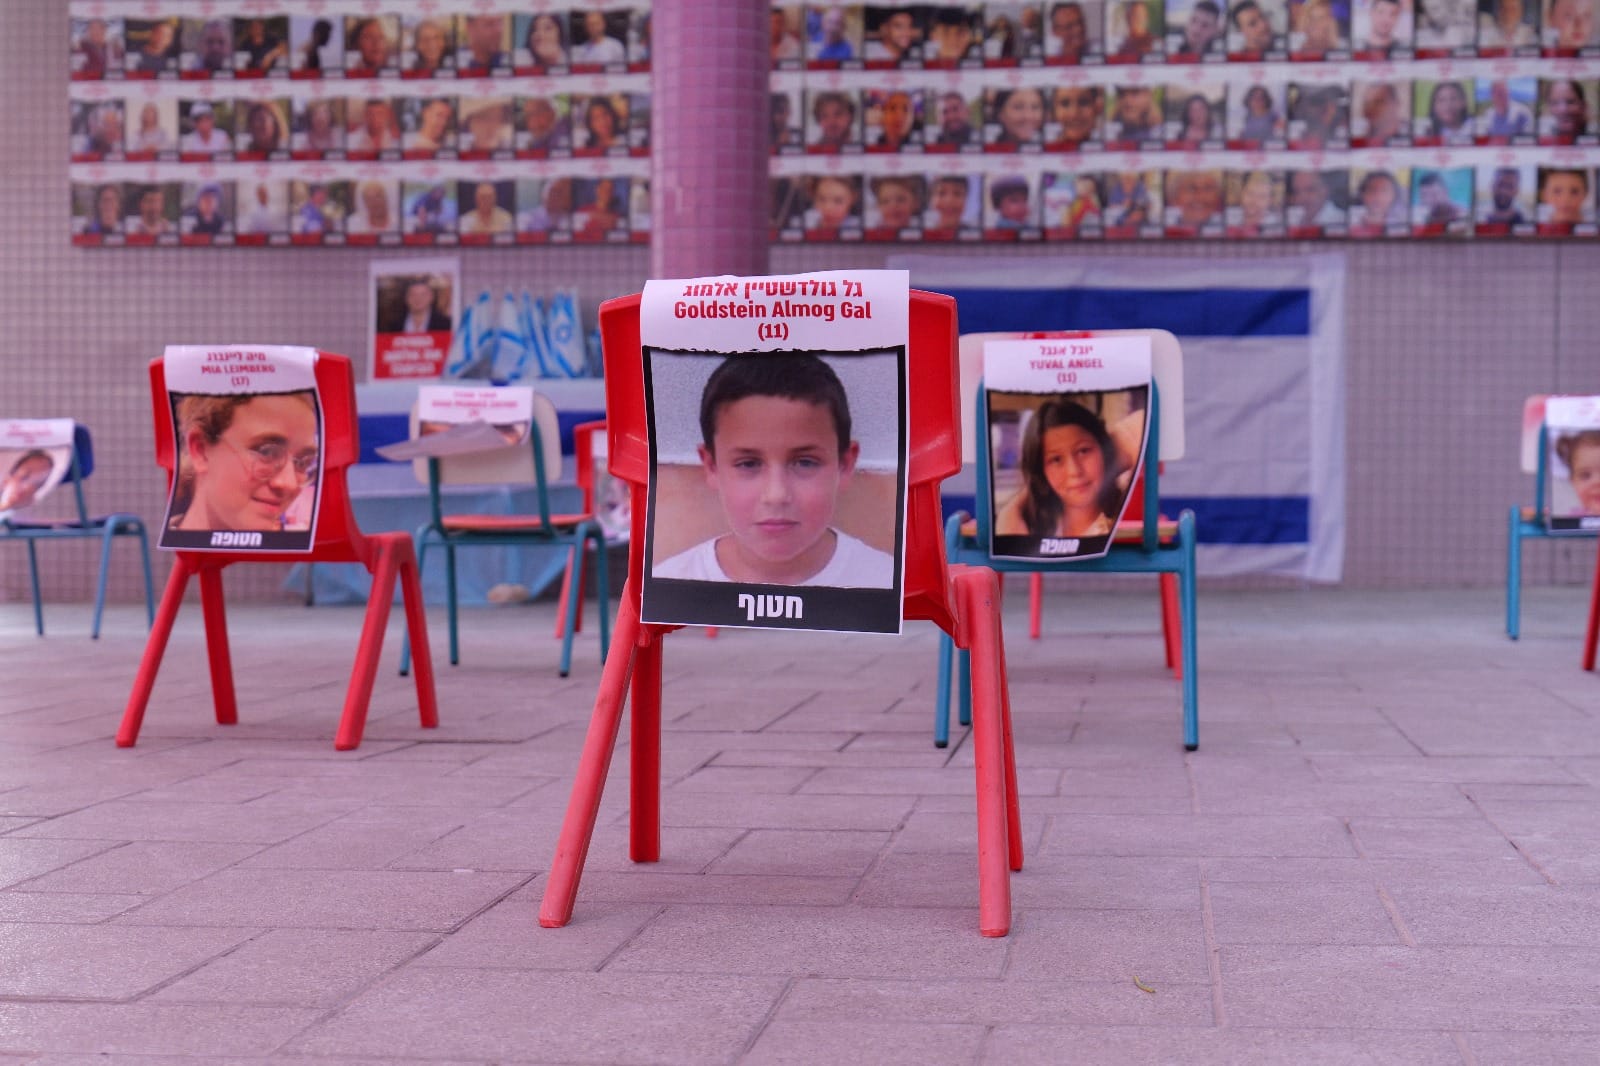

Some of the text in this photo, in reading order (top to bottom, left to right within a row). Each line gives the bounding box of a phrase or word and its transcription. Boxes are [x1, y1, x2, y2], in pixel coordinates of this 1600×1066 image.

[683, 279, 863, 299] גל גולדשטיין אלמוג
[674, 300, 872, 321] Goldstein Almog Gal
[758, 323, 789, 341] (11)
[201, 364, 275, 374] MIA LEIMBERG
[1029, 358, 1104, 369] YUVAL ANGEL
[1057, 372, 1077, 384] (11)
[211, 532, 262, 546] חטופה
[738, 593, 803, 621] חטוף
